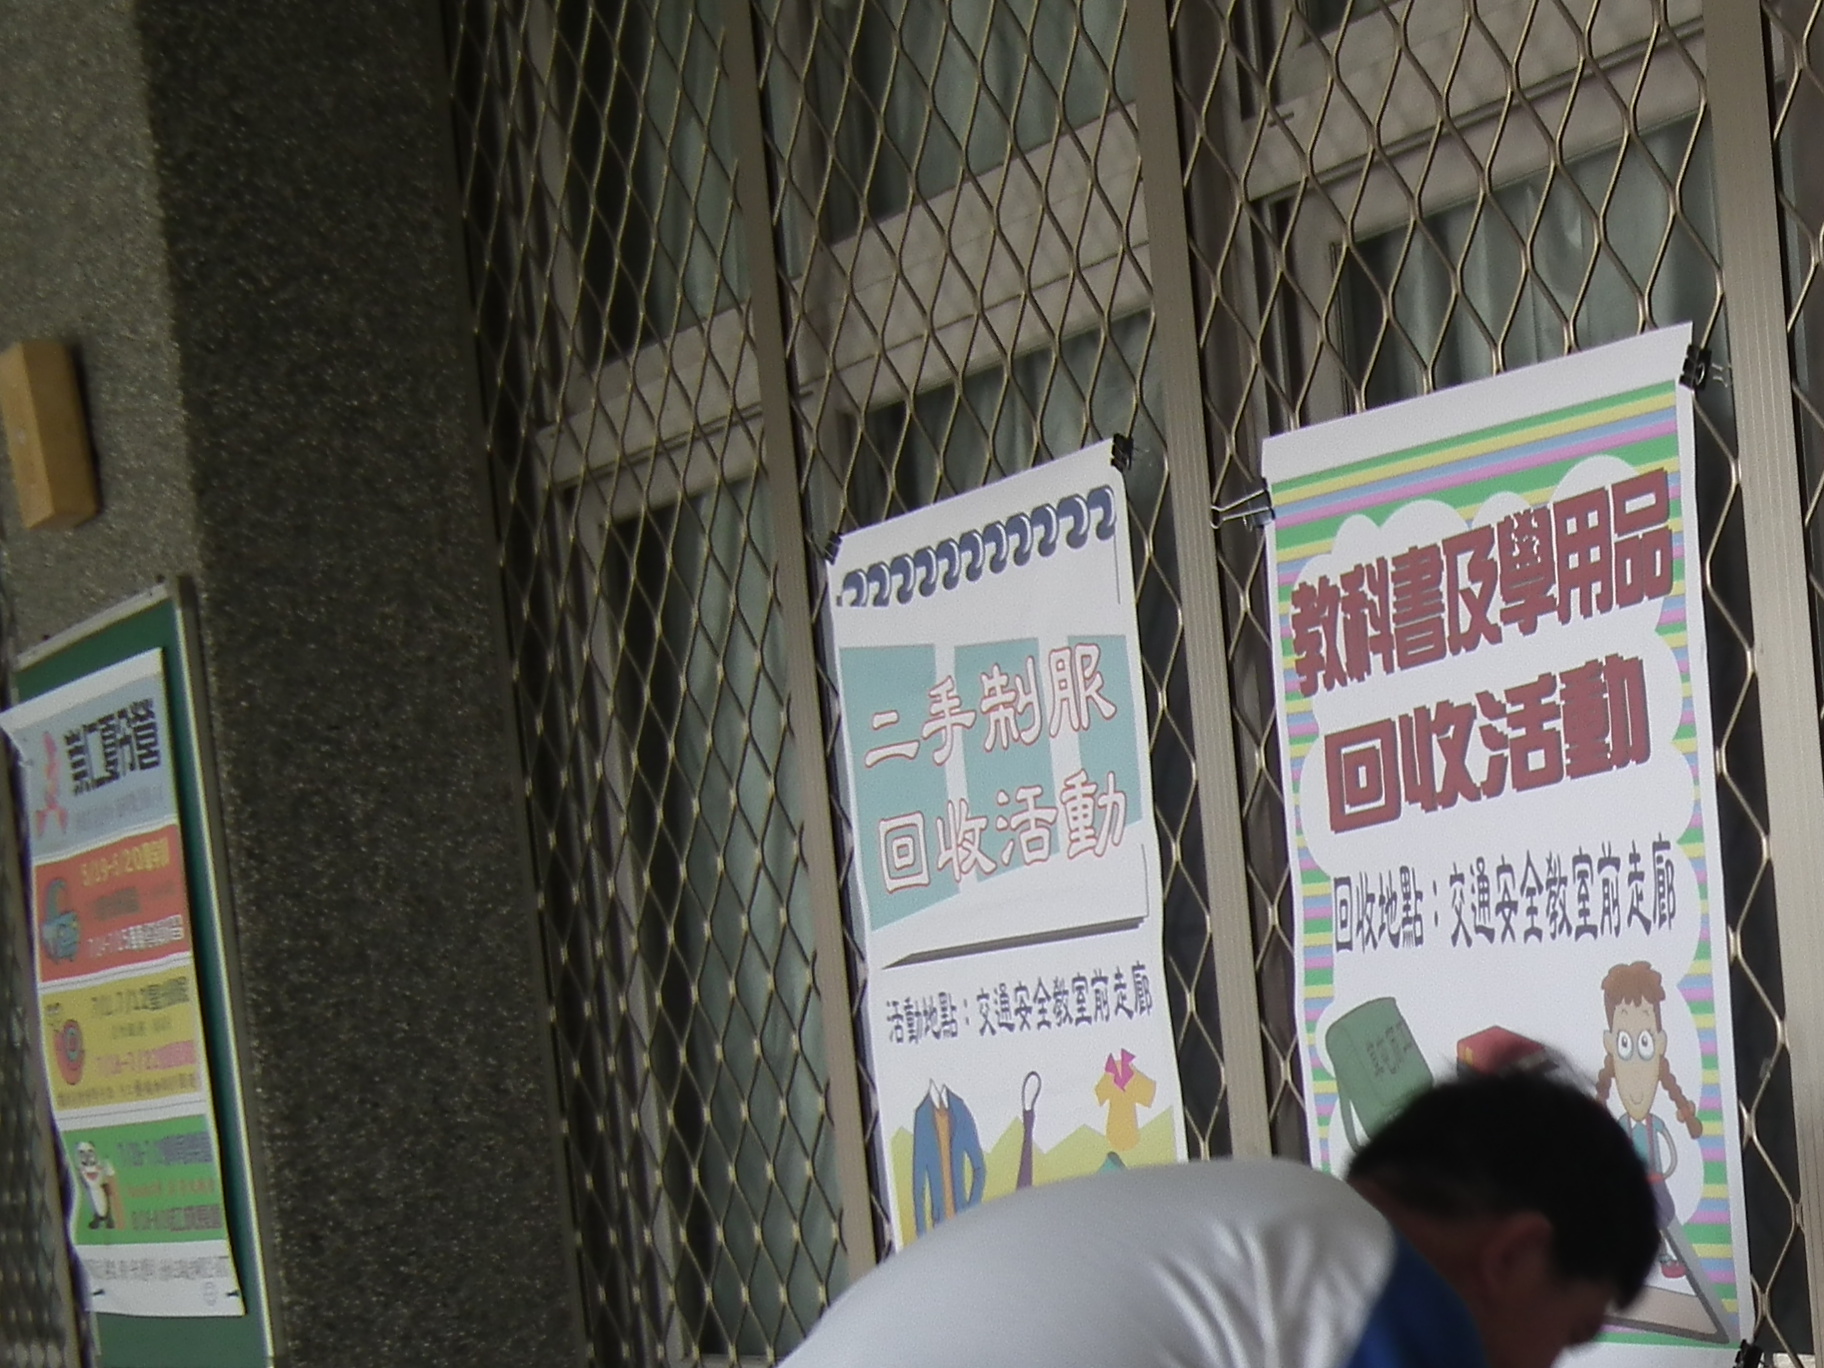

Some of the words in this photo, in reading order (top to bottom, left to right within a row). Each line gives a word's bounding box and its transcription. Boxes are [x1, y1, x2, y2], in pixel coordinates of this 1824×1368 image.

[1291, 467, 1675, 695] 教科書及學用品
[865, 644, 1115, 767] 二手制服
[1325, 653, 1651, 834] 回收活動
[879, 770, 1127, 893] 回收活動
